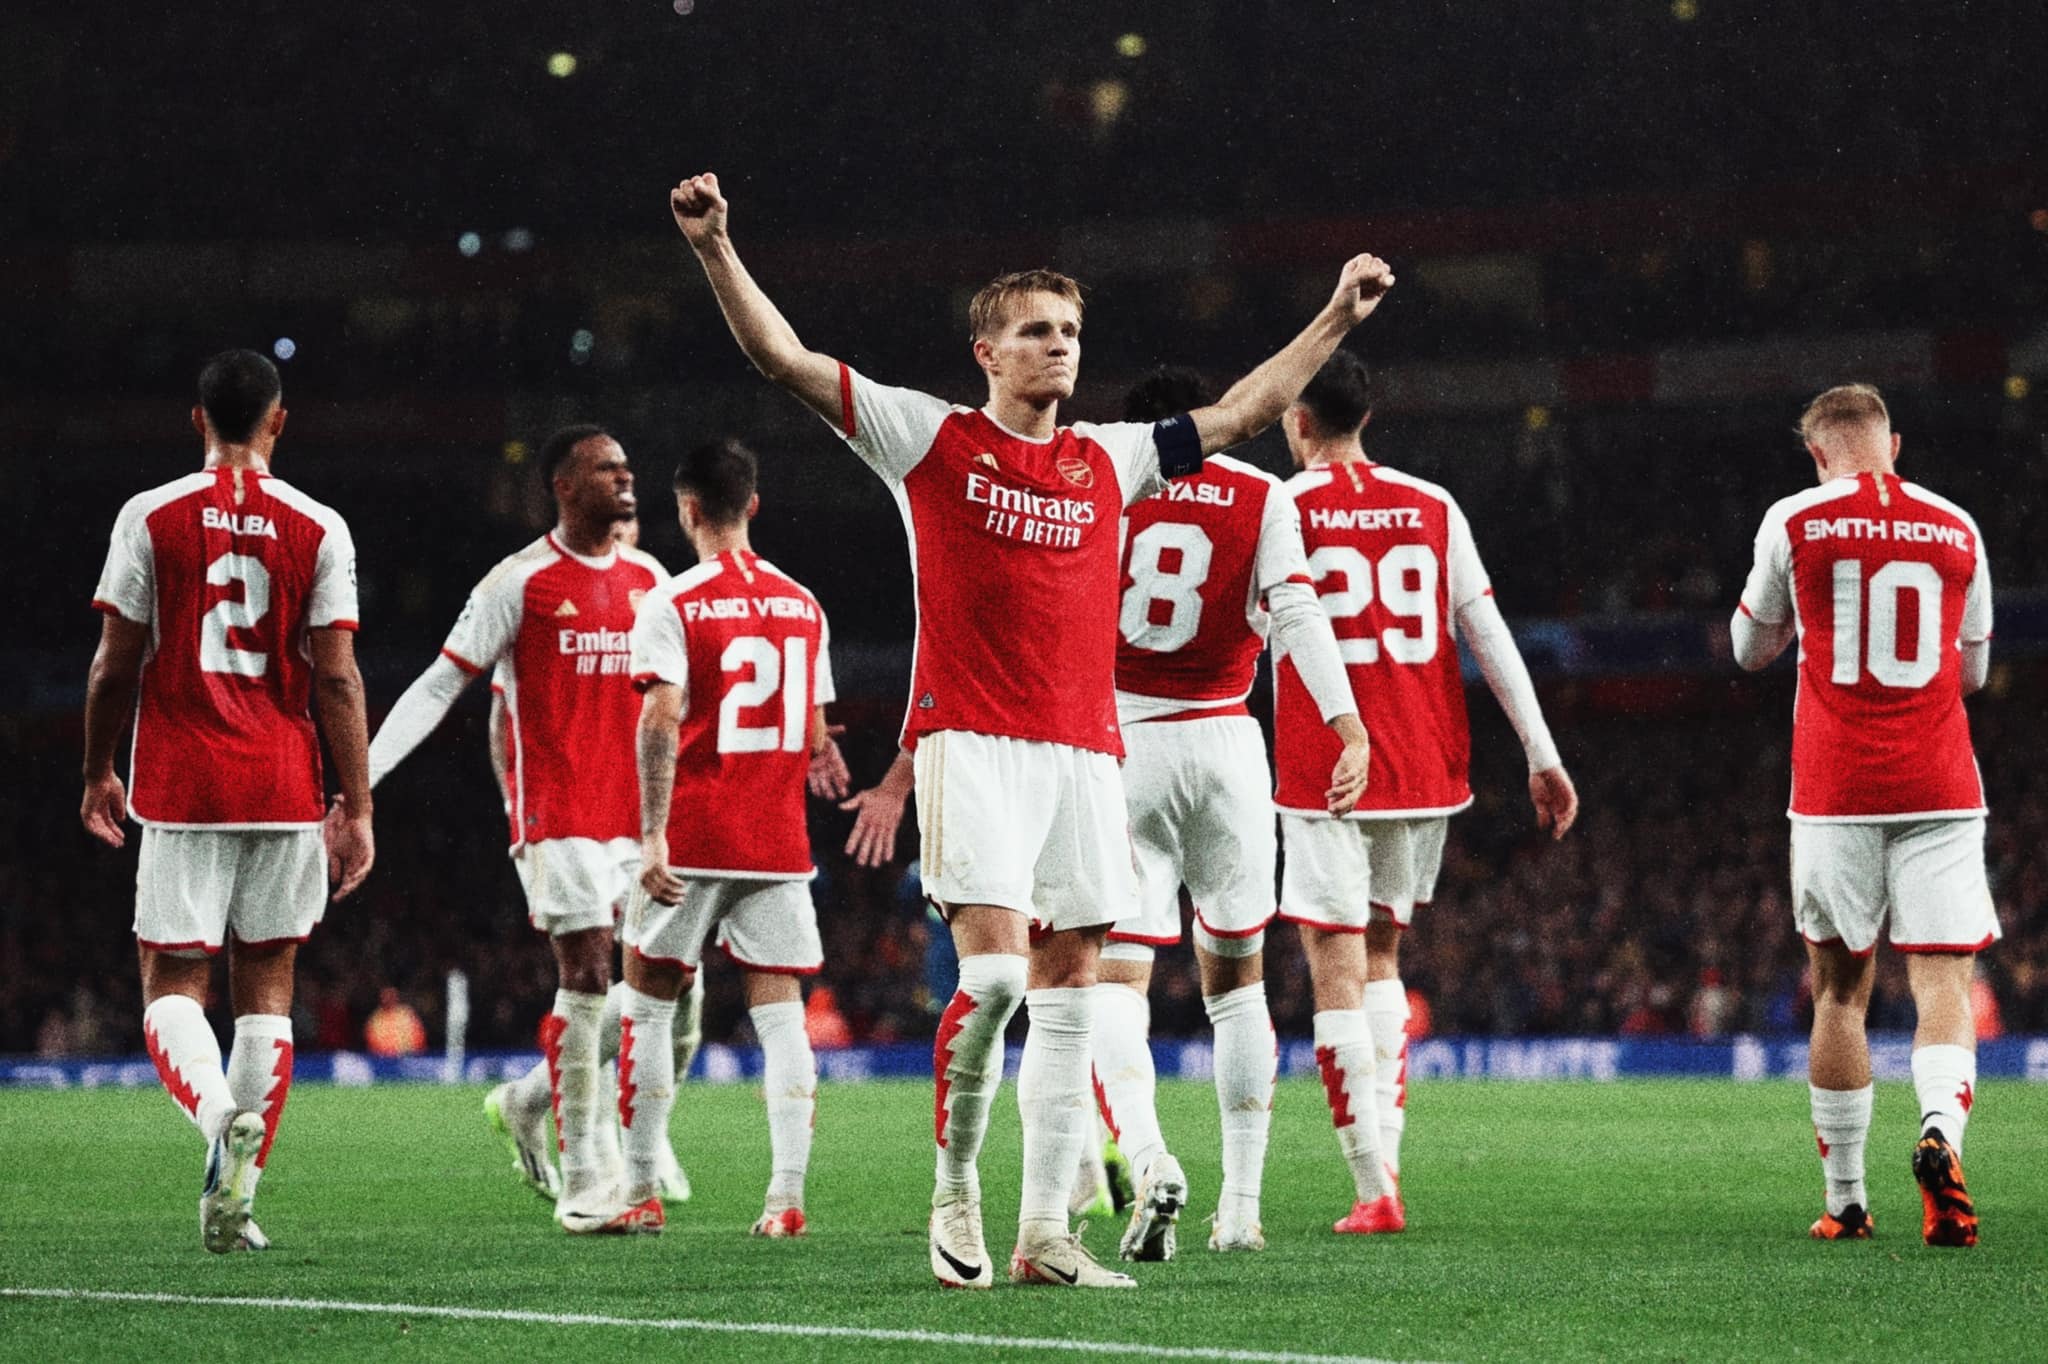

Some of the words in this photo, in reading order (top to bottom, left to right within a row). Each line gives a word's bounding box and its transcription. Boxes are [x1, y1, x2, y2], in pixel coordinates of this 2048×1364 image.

[966, 472, 1095, 524] Emirates
[986, 509, 1018, 537] FLY
[1022, 517, 1081, 548] BETTER
[1149, 481, 1235, 507] YASU
[1309, 507, 1423, 530] HAVERTZ
[1804, 518, 1887, 541] SMITH
[1893, 520, 1969, 551] ROWE
[200, 551, 270, 677] 2
[1118, 516, 1213, 652] 8
[1309, 544, 1438, 664] 29
[1831, 558, 1942, 688] 10
[717, 636, 807, 753] 21
